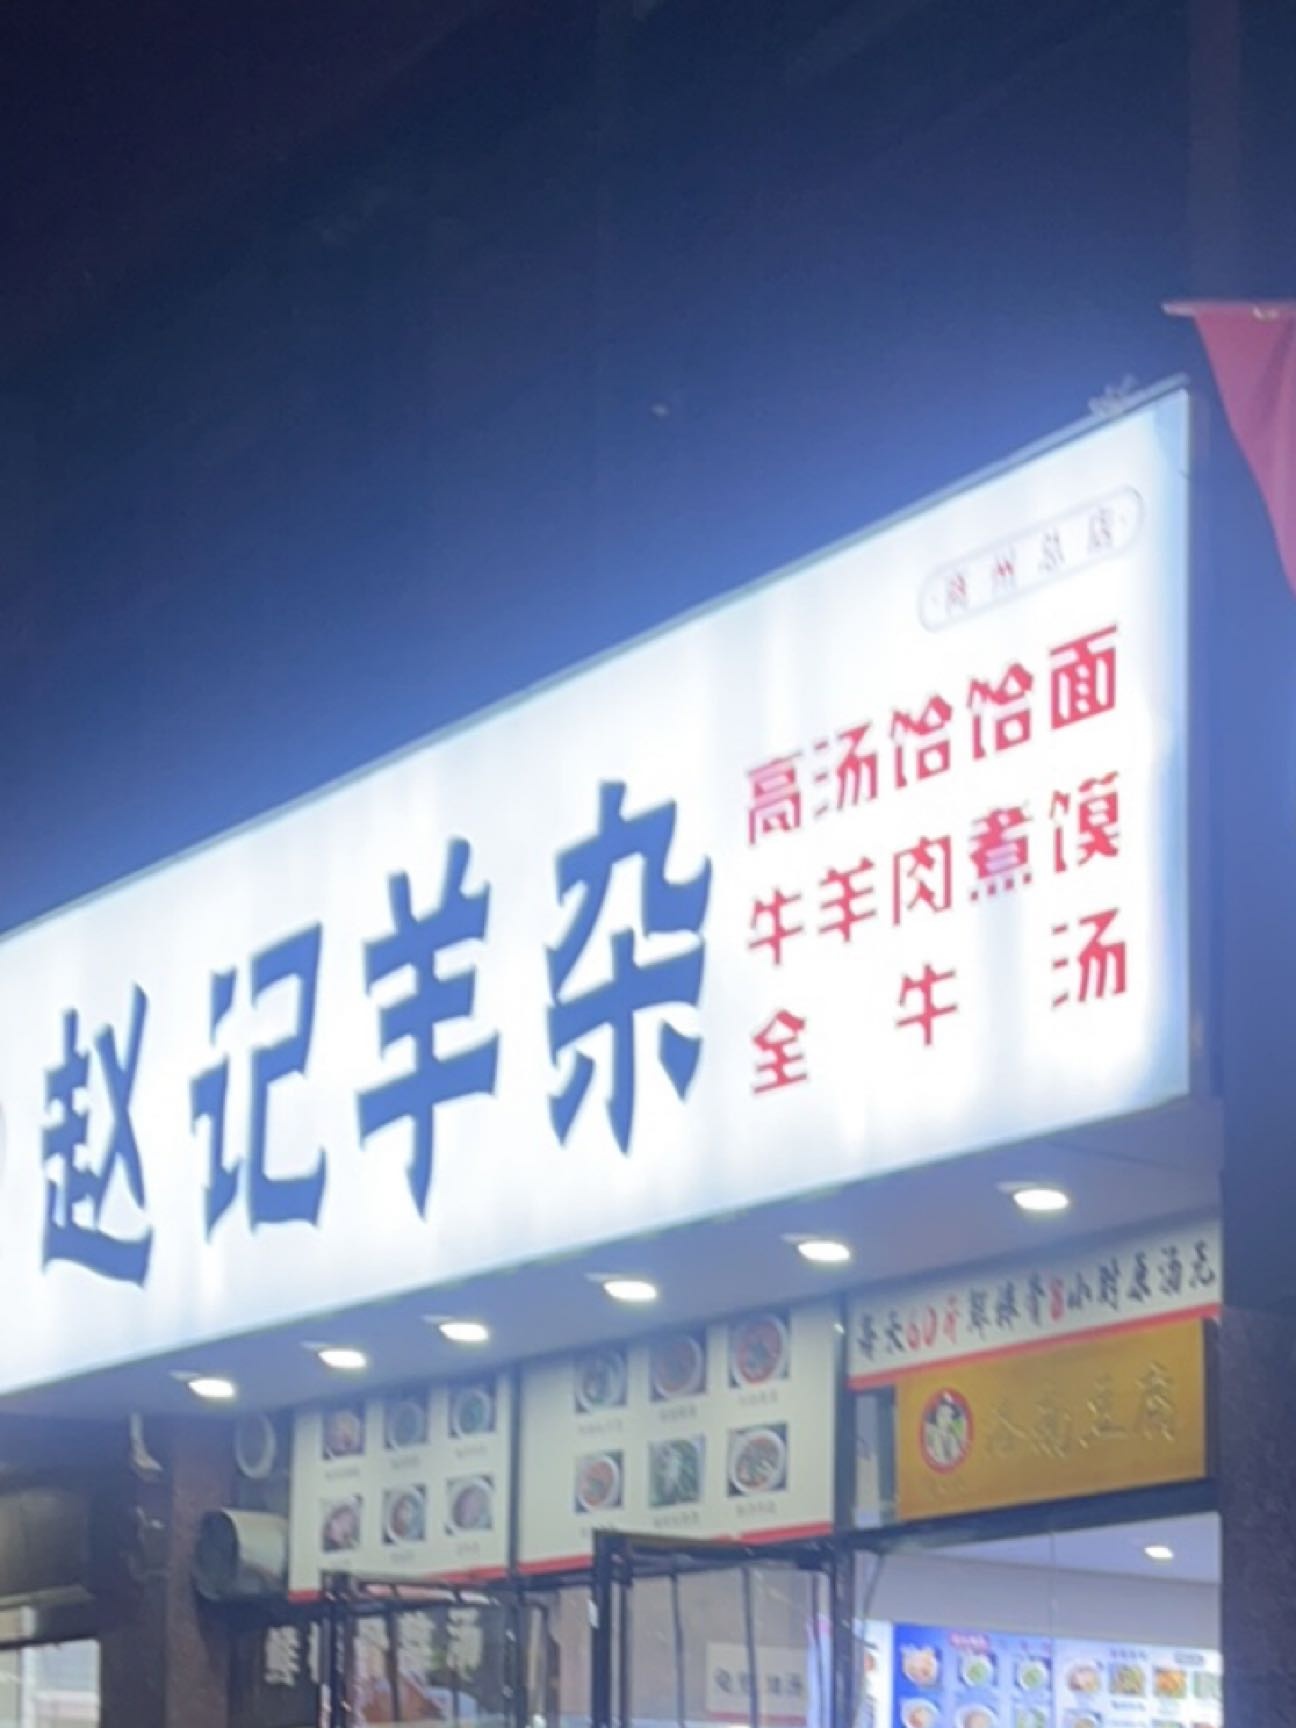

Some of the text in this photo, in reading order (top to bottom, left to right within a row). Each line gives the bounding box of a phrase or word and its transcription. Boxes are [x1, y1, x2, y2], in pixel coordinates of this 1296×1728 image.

[42, 781, 712, 1289] 赵记羊杂
[748, 771, 1120, 966] 牛羊肉煮馍
